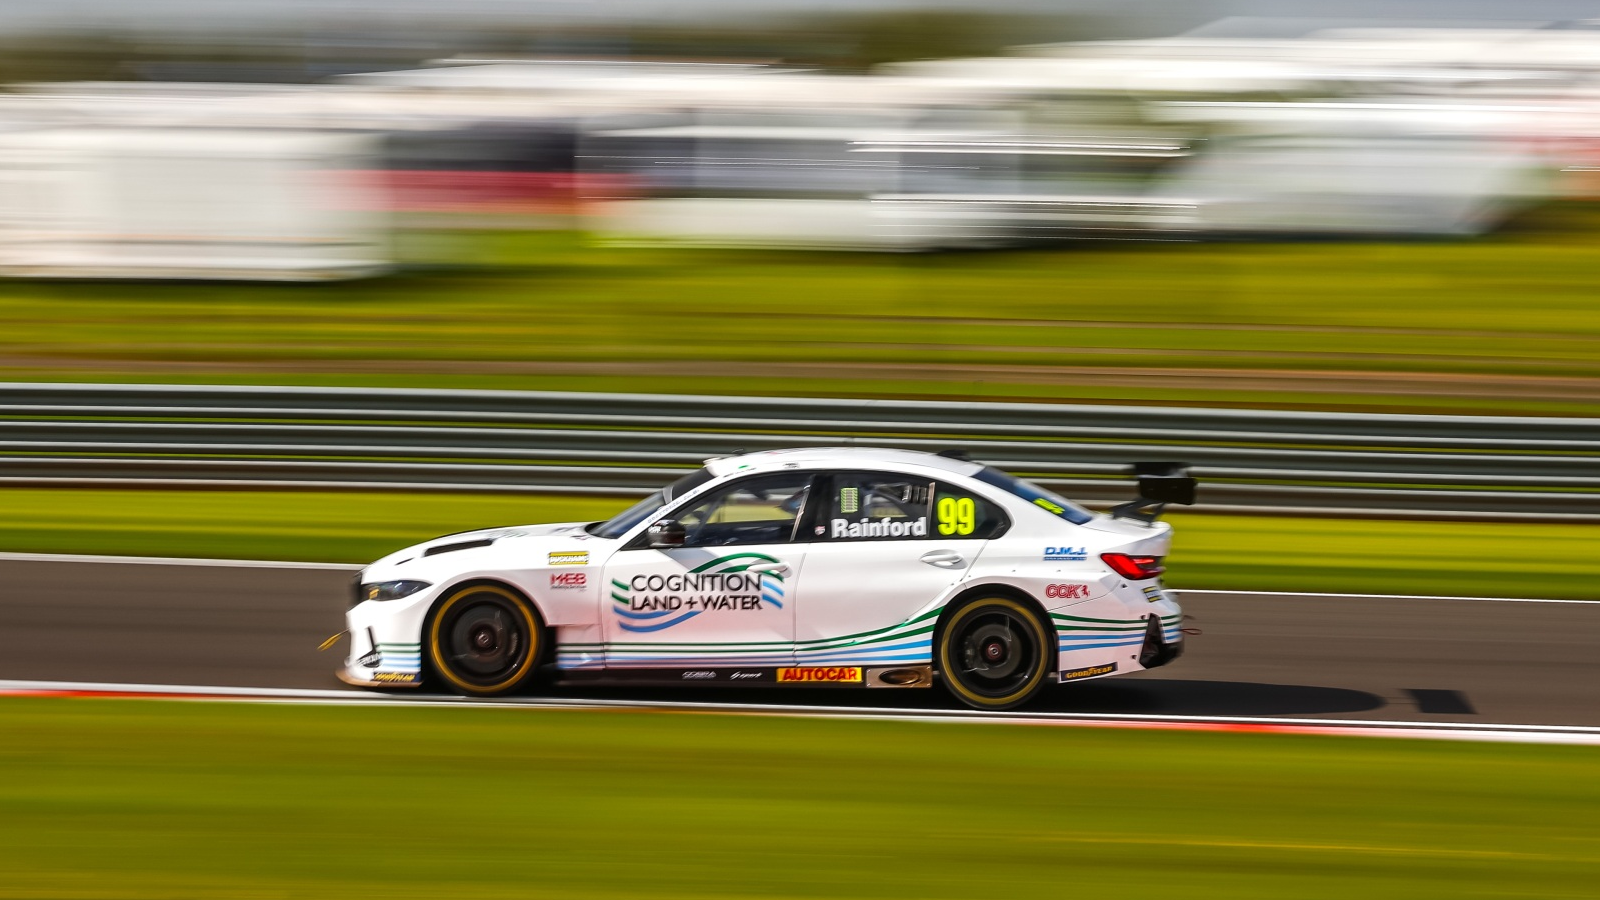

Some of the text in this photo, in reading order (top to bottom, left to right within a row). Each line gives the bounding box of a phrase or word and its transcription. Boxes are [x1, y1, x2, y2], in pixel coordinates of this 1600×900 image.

[937, 497, 975, 536] 99
[831, 516, 927, 539] Rainford
[550, 572, 587, 585] MEB
[631, 573, 762, 593] COGNITION
[1046, 583, 1082, 599] CCK
[631, 595, 682, 611] LAND
[699, 594, 764, 611] WATER
[783, 667, 858, 681] AUTOCAR
[1065, 665, 1113, 679] GOODYEAR
